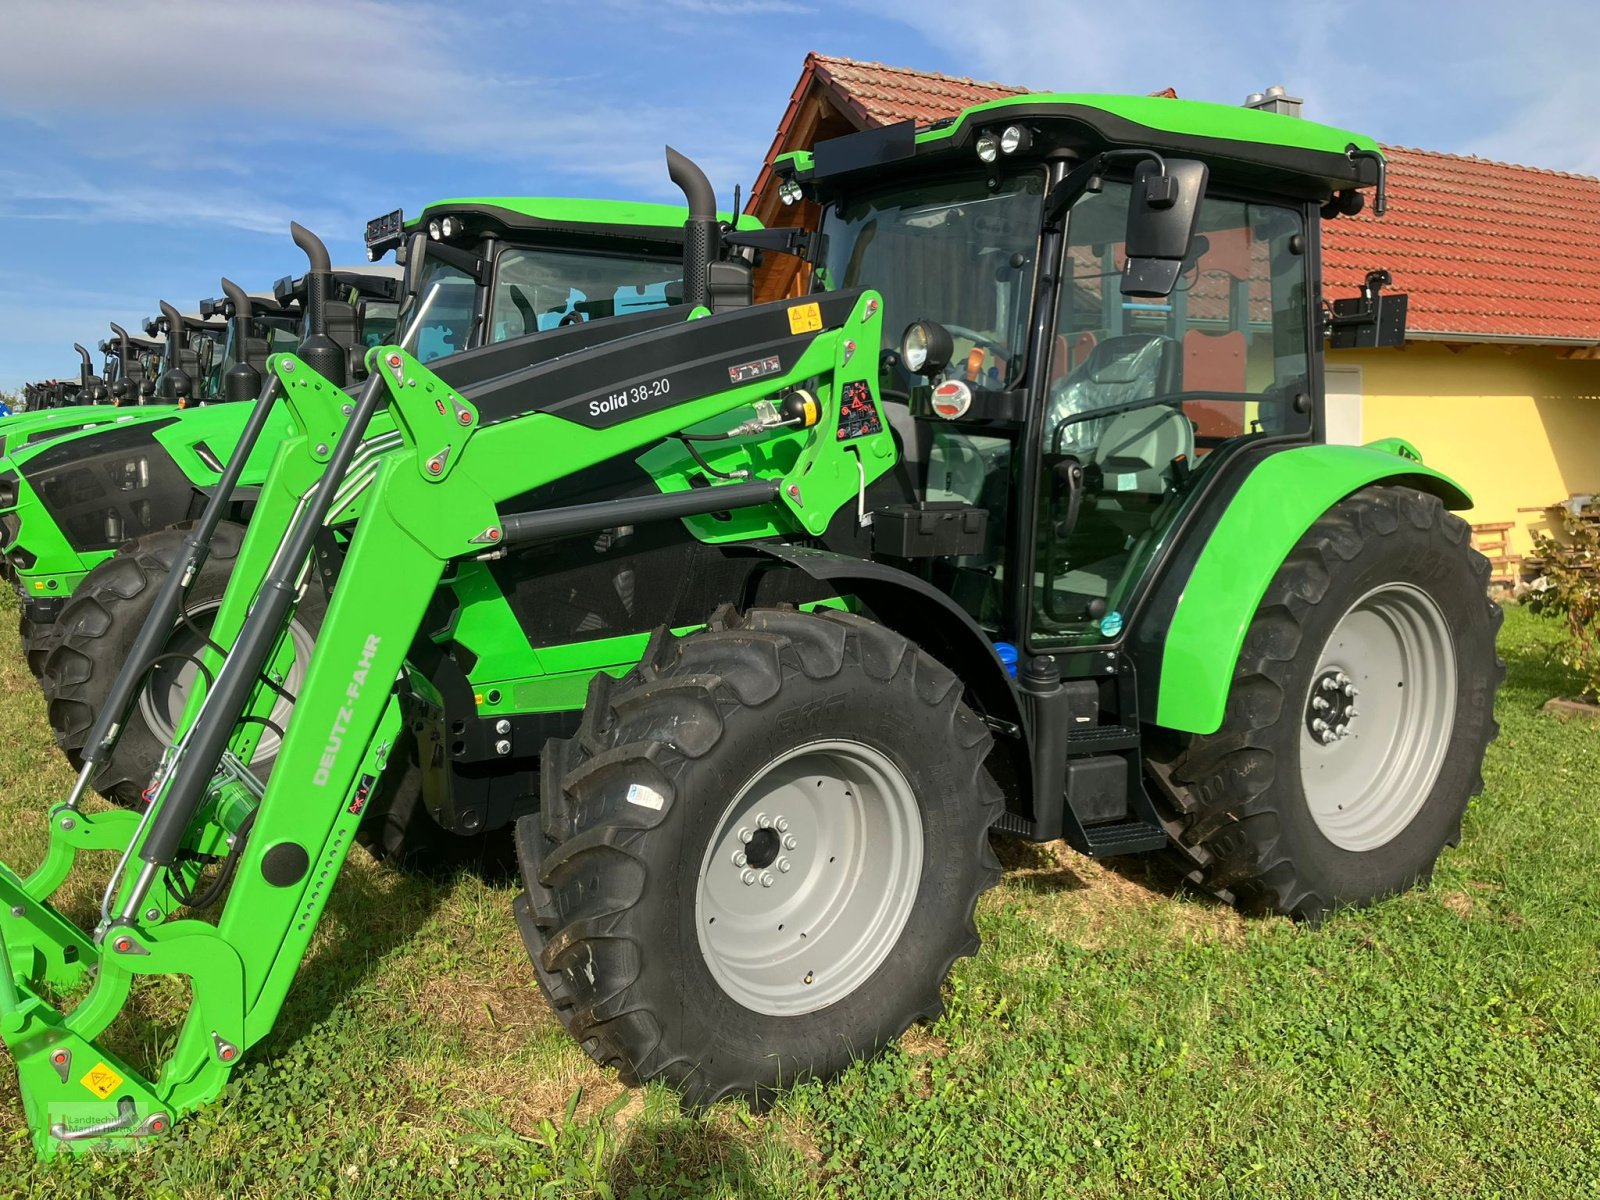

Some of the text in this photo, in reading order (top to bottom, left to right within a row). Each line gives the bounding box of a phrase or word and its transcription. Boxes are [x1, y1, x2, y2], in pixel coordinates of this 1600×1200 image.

[589, 378, 670, 416] Solid 38-20
[312, 633, 381, 787] DEUTZ-FAHR
